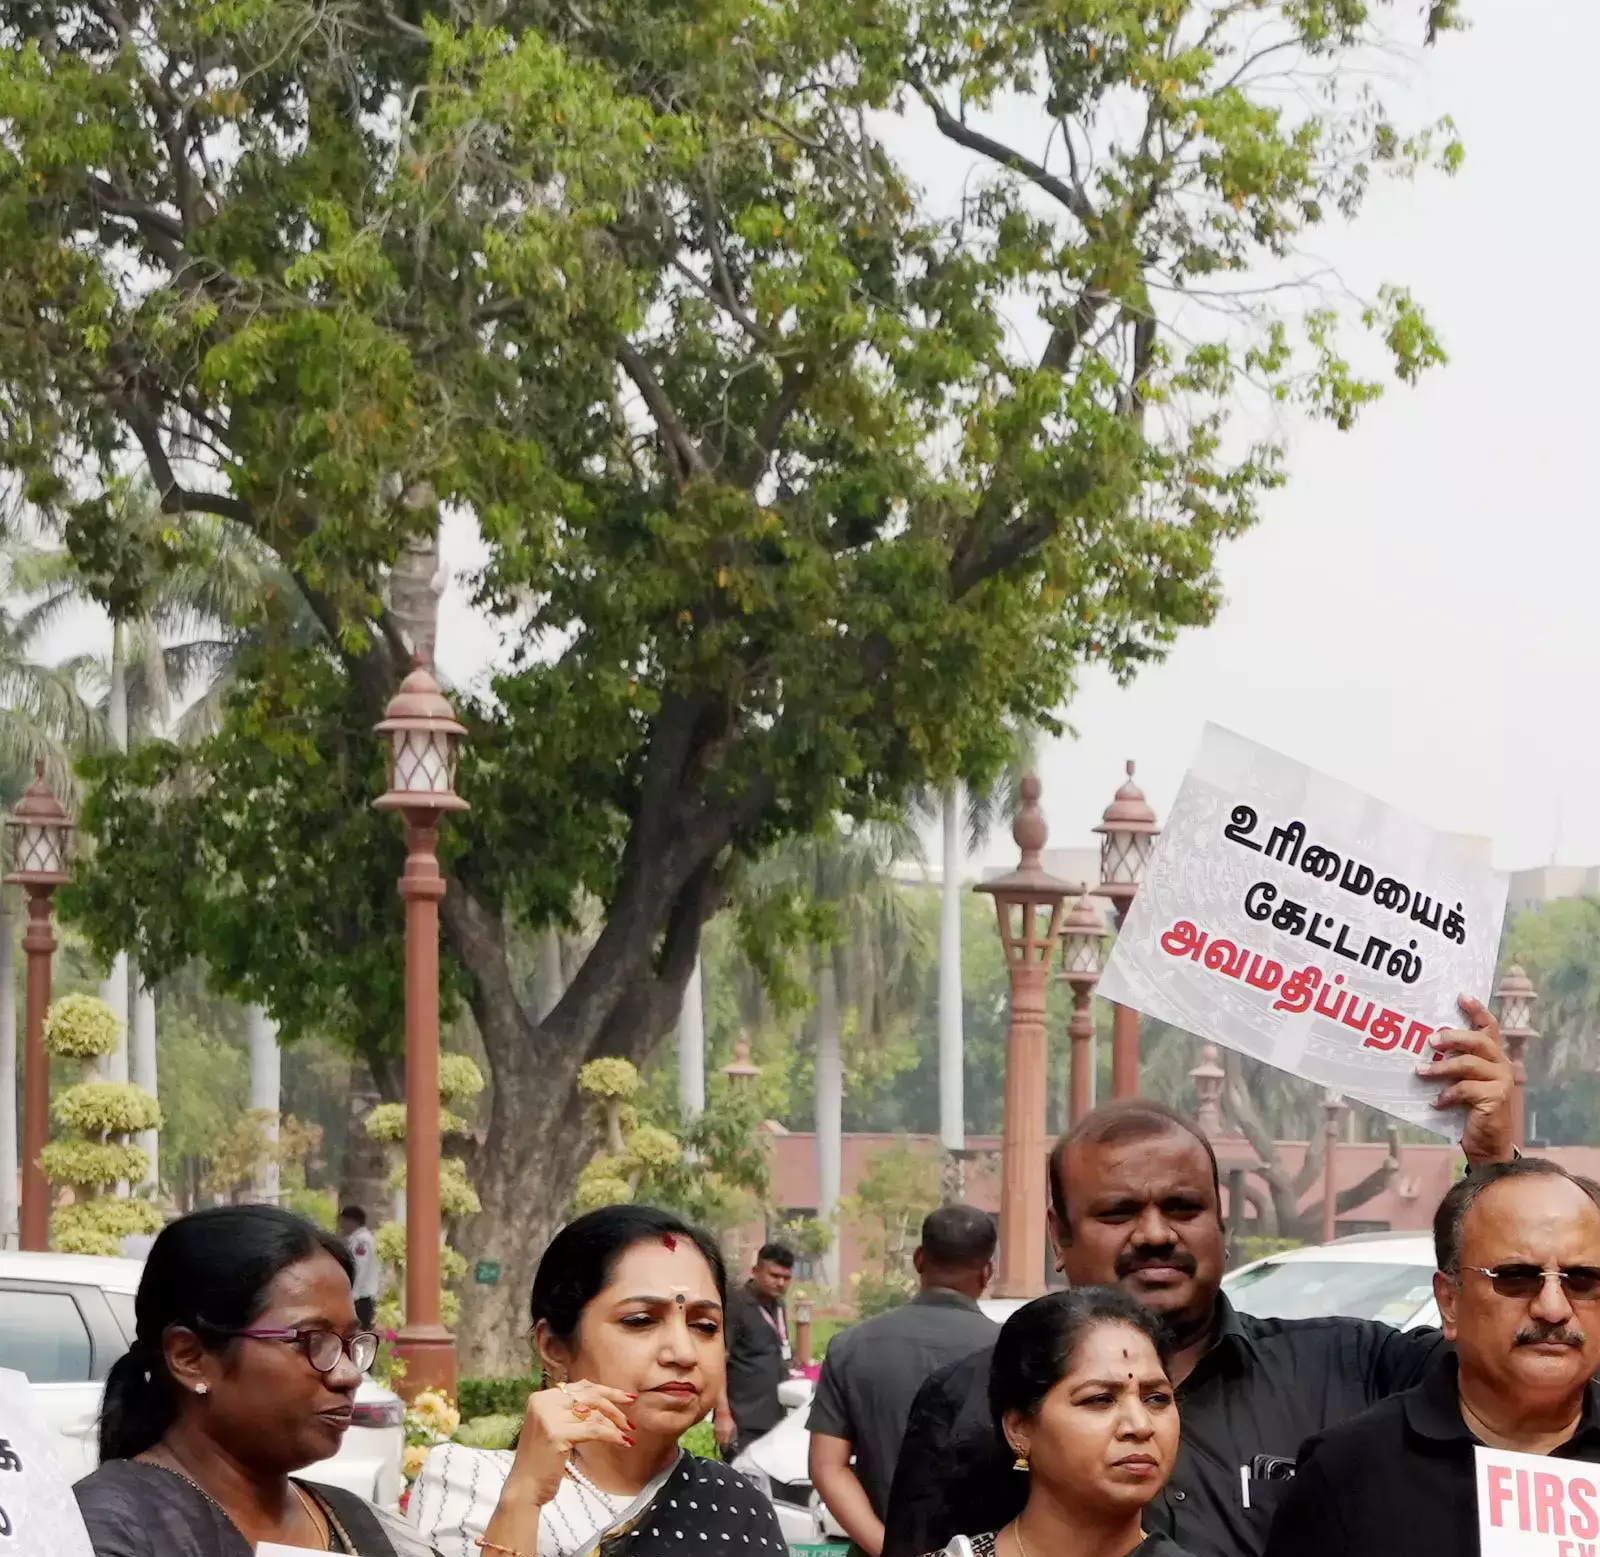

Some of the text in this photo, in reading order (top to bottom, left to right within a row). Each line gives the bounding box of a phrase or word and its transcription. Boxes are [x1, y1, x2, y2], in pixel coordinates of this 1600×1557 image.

[1224, 805, 1466, 945] உரிமையைக்
[1245, 882, 1422, 984] கேட்டால்
[1161, 920, 1452, 1061] அவமதிப்பதா
